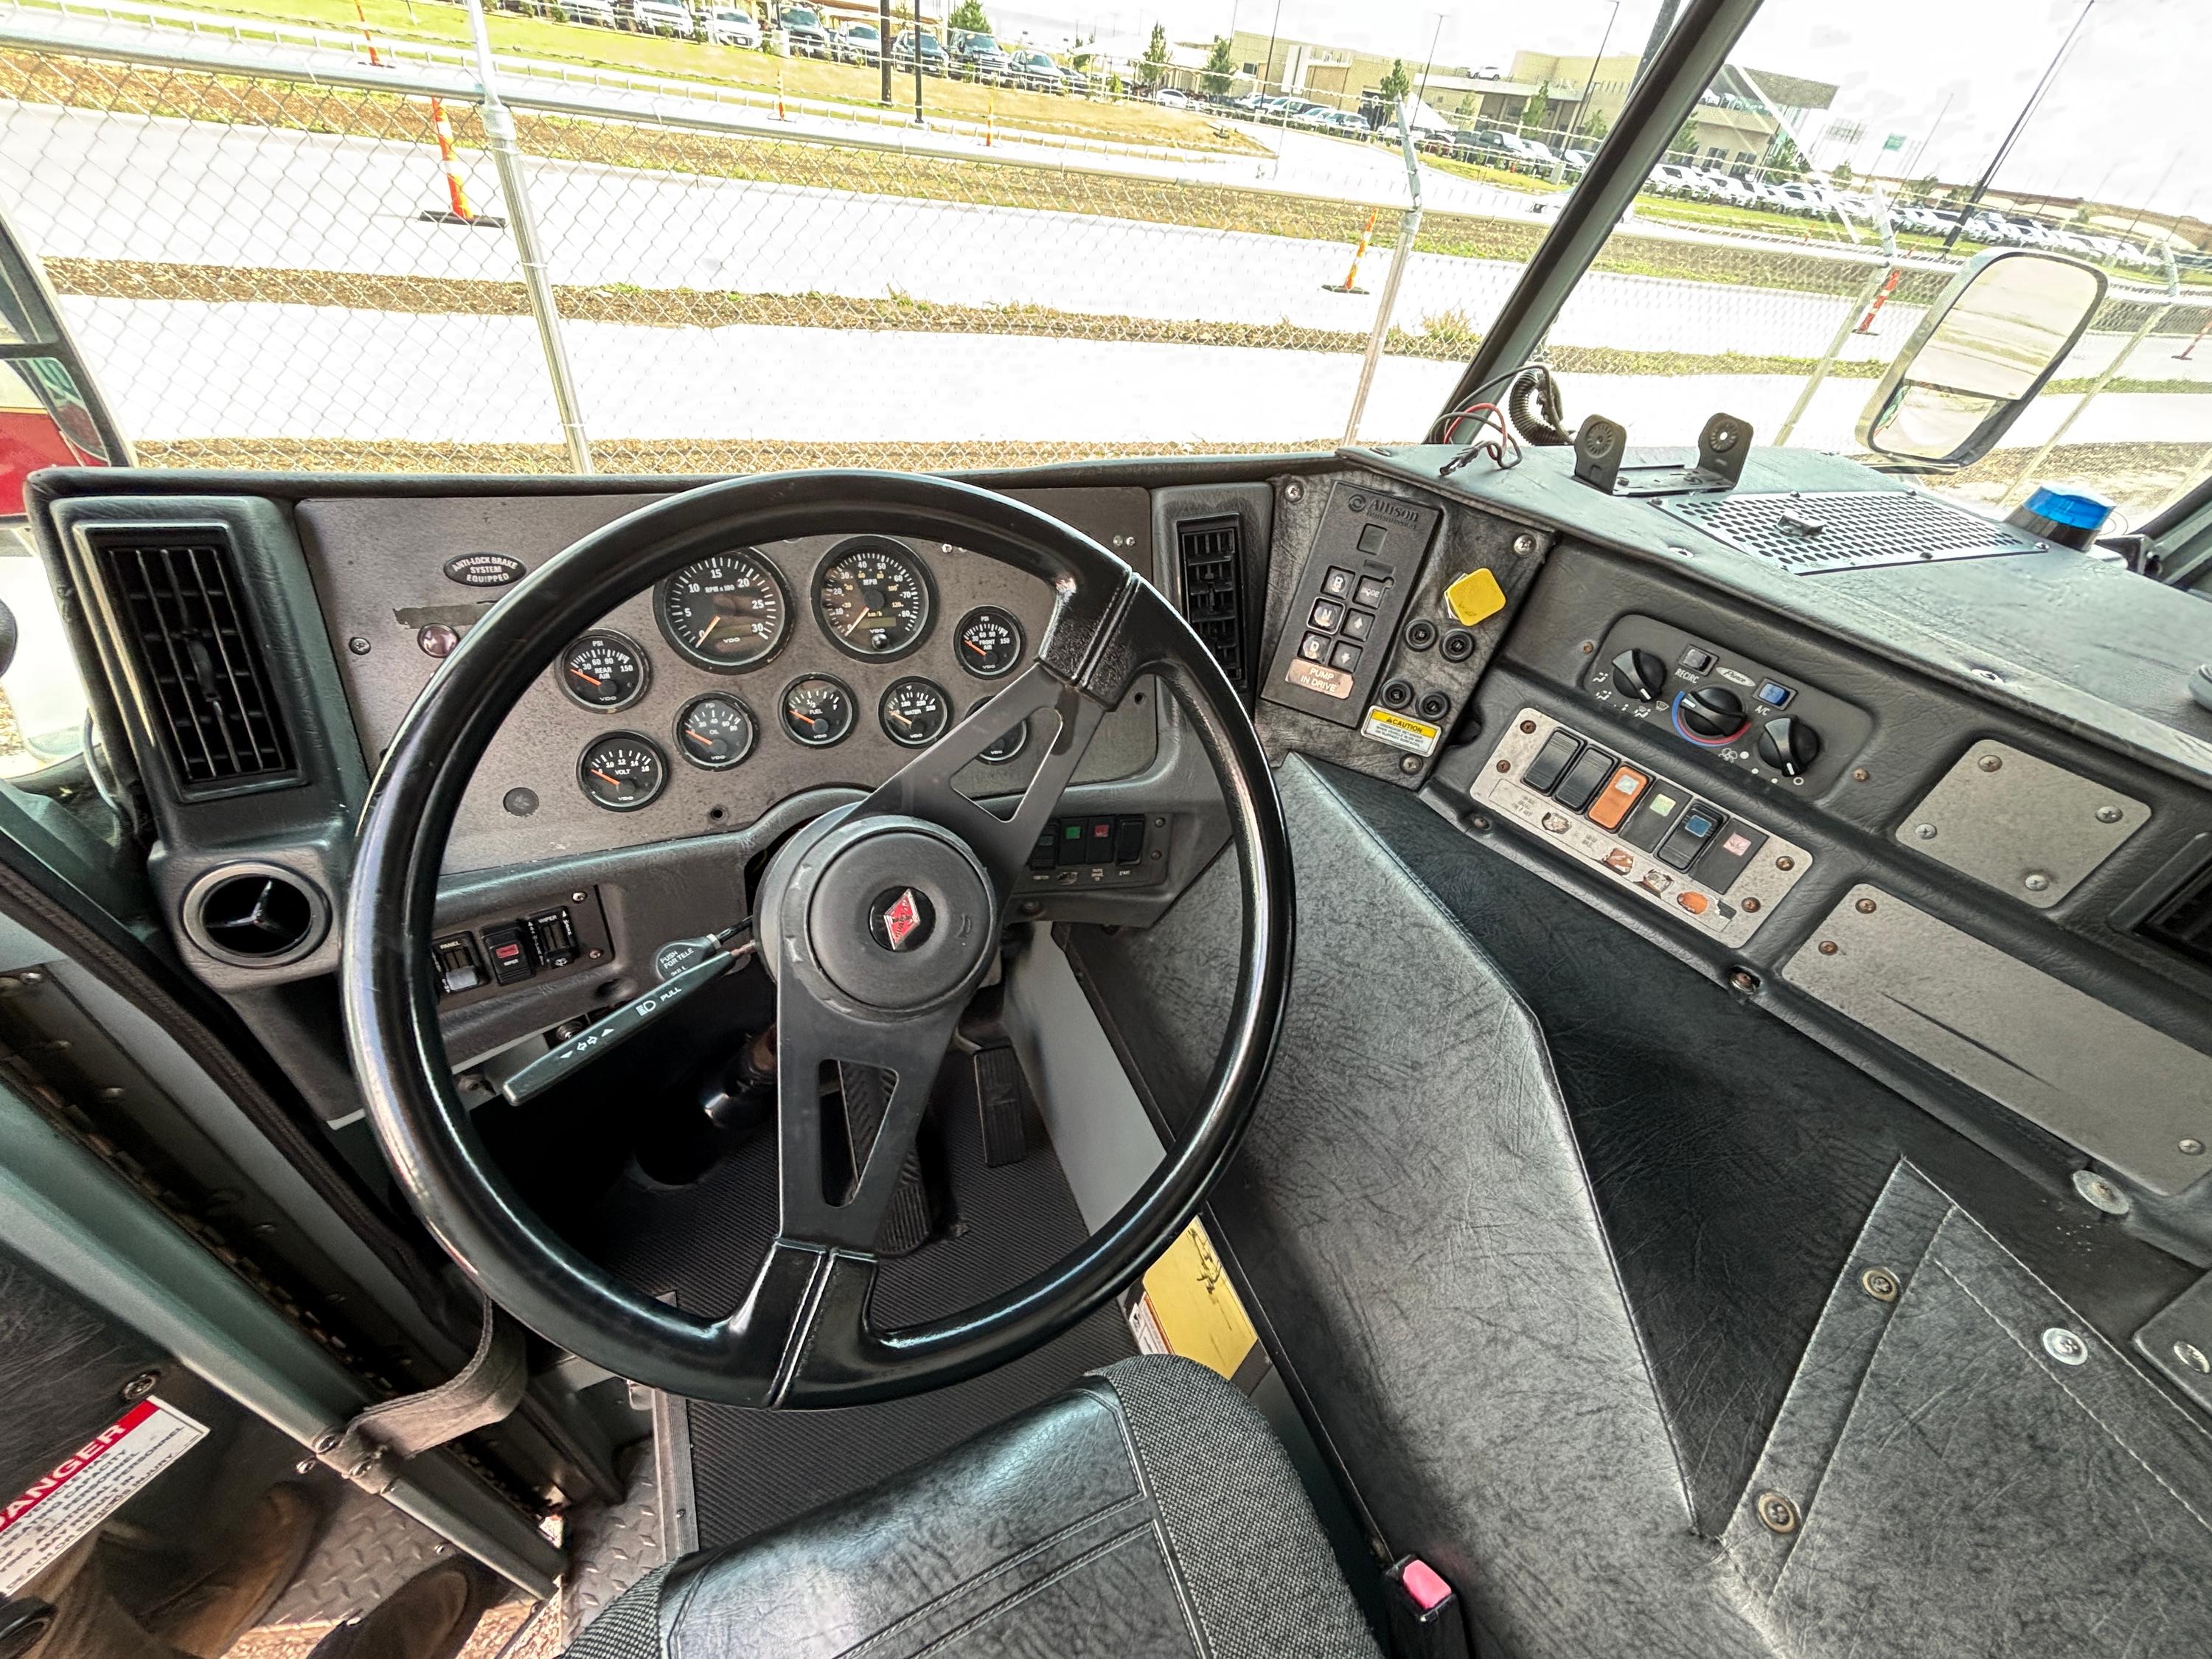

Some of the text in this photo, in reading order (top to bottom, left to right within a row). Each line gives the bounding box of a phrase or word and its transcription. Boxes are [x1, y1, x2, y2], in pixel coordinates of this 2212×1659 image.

[1368, 499, 1419, 522] Allison
[451, 557, 518, 572] ANTI-LOCK BRAKE
[470, 566, 501, 574] SYSTEM
[466, 573, 509, 582] EQUIPPED
[711, 568, 722, 579] 15
[689, 583, 700, 593] 10
[737, 578, 750, 588] 20
[752, 599, 764, 609] 25
[685, 608, 692, 617] 5
[752, 624, 763, 633] 30
[1309, 667, 1335, 680] PUMP
[1675, 668, 1700, 684] RECIRC
[1300, 675, 1338, 692] IN DRIVE
[1755, 705, 1770, 716] A/C
[1392, 719, 1422, 733] CAUTION
[440, 940, 462, 950] PANEL
[660, 950, 678, 964] PUSH
[663, 947, 695, 969] FOR TELE
[660, 987, 682, 1001] PULL
[23, 1475, 82, 1519] VEHICLE
[83, 1452, 110, 1473] HAS
[35, 1484, 114, 1545] ADDITIONAL
[112, 1426, 185, 1481] PERSONNEL
[63, 1451, 142, 1510] PERSONNEL
[1, 1449, 126, 1547] SEATING CAPACITY
[6, 1552, 53, 1589] DEATH
[131, 1453, 173, 1486] INJURY
[38, 1528, 67, 1552] MAY
[70, 1487, 119, 1526] RESULT
